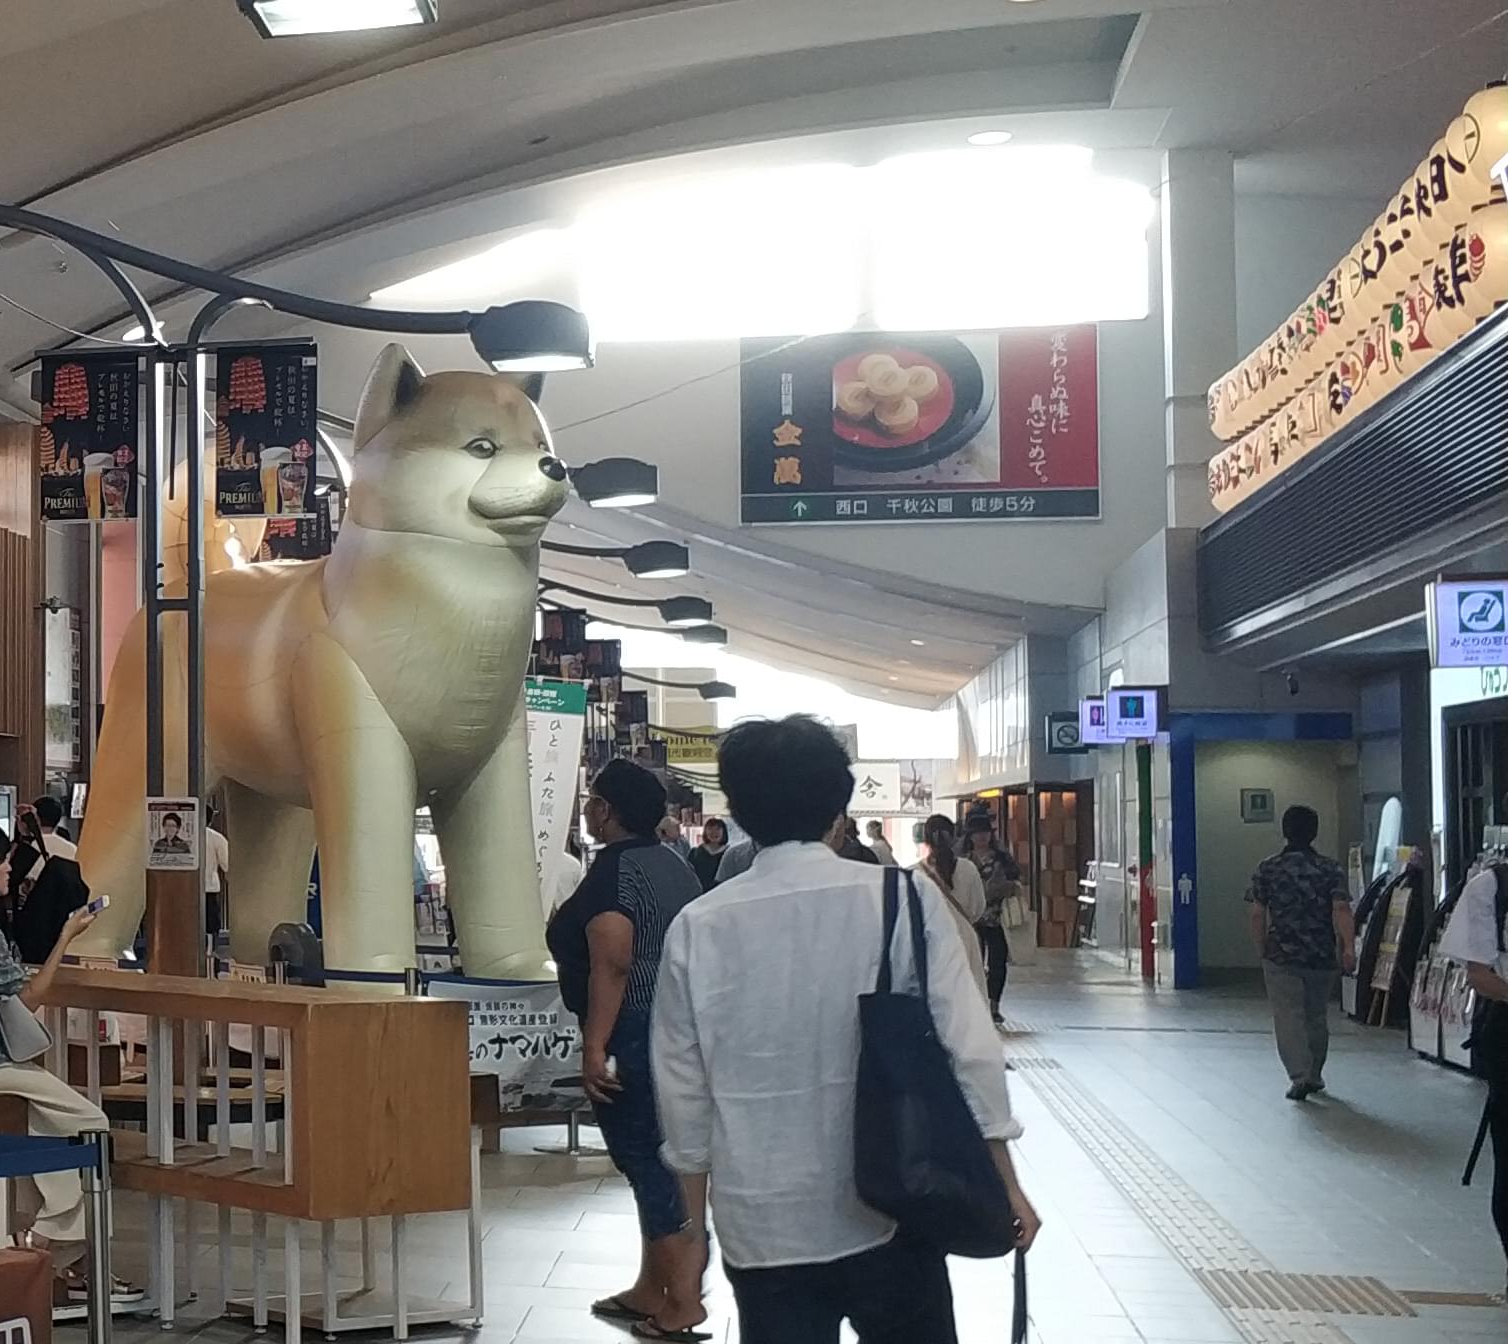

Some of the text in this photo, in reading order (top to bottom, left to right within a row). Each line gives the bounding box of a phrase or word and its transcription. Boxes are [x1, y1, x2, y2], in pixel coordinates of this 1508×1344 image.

[835, 499, 868, 515] 西口
[970, 496, 1037, 513] 徒歩5分
[469, 1028, 576, 1061] のナマハゲ
